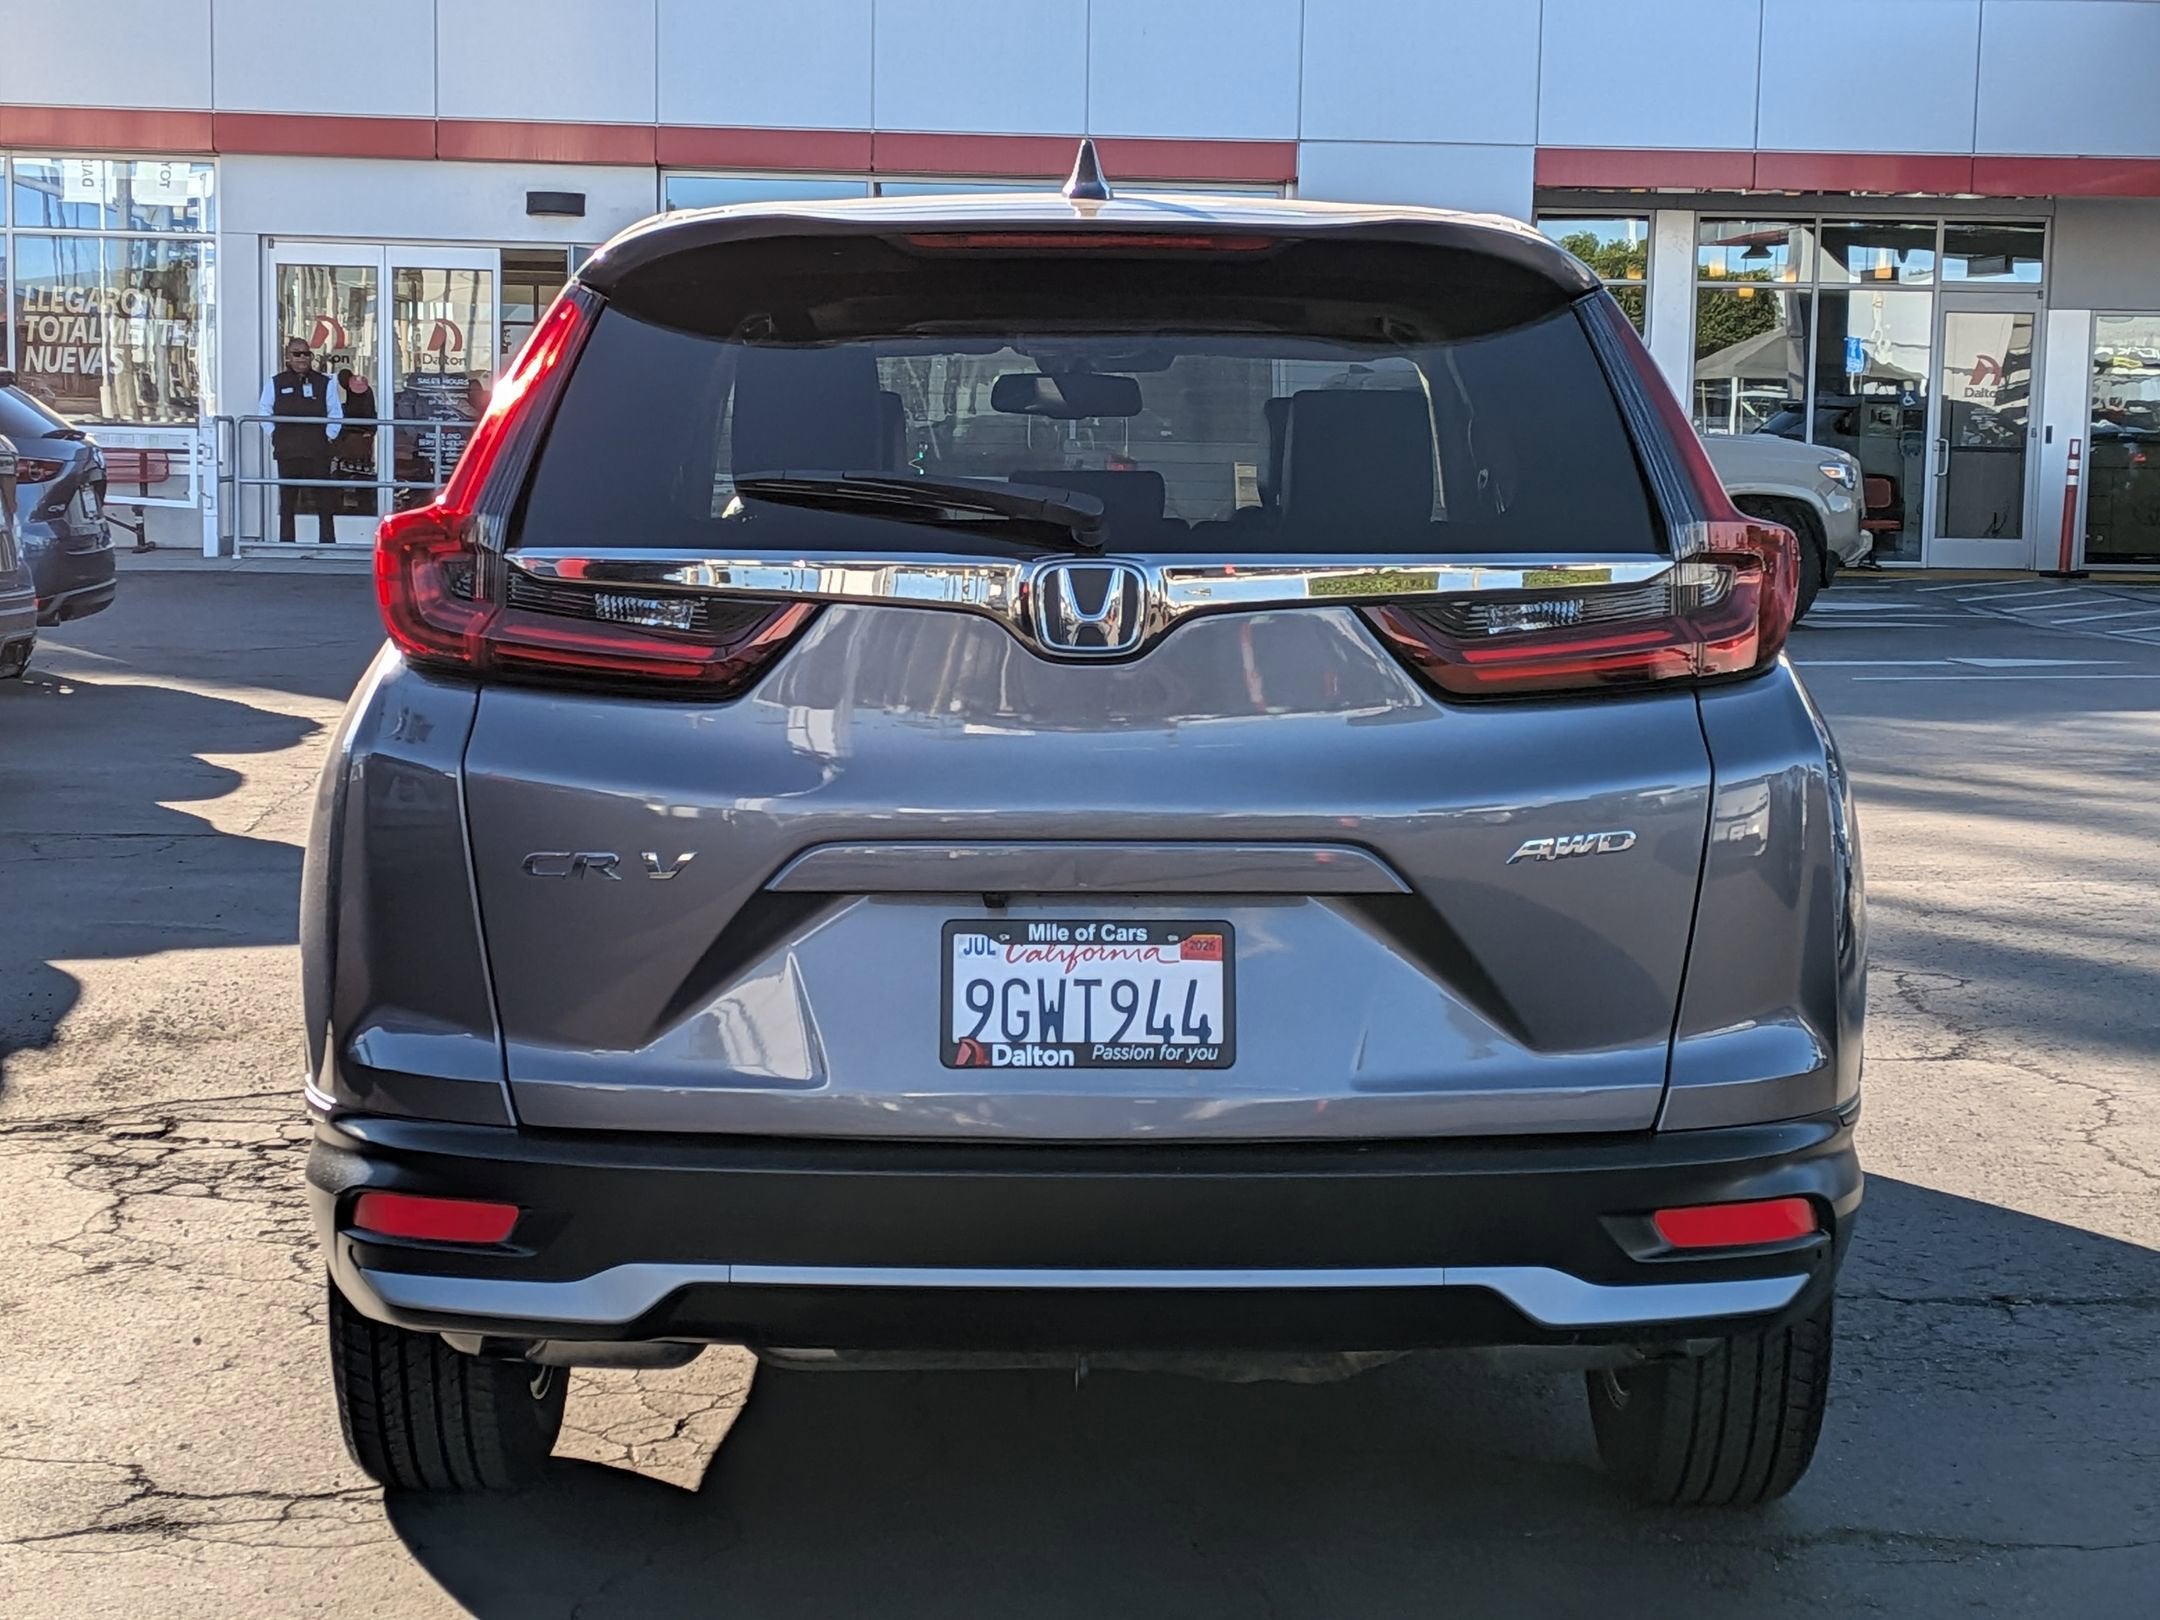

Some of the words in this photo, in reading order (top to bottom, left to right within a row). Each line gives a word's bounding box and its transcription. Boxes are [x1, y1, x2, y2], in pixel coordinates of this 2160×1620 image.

[22, 284, 163, 316] LLEGARON
[24, 315, 187, 346] TOTALMETE
[23, 345, 124, 375] NUEVAS
[1964, 387, 1999, 398] Dalto
[1505, 830, 1637, 865] AWD
[963, 937, 996, 956] JUL
[1028, 923, 1069, 942] Mile
[1074, 923, 1097, 942] of
[1100, 923, 1148, 942] Cars
[1005, 944, 1180, 974] California
[965, 978, 1213, 1044] 9GWT944
[991, 1043, 1075, 1067] Dalton
[1092, 1044, 1155, 1061] Passion
[1158, 1044, 1184, 1062] for
[1185, 1047, 1219, 1064] you
